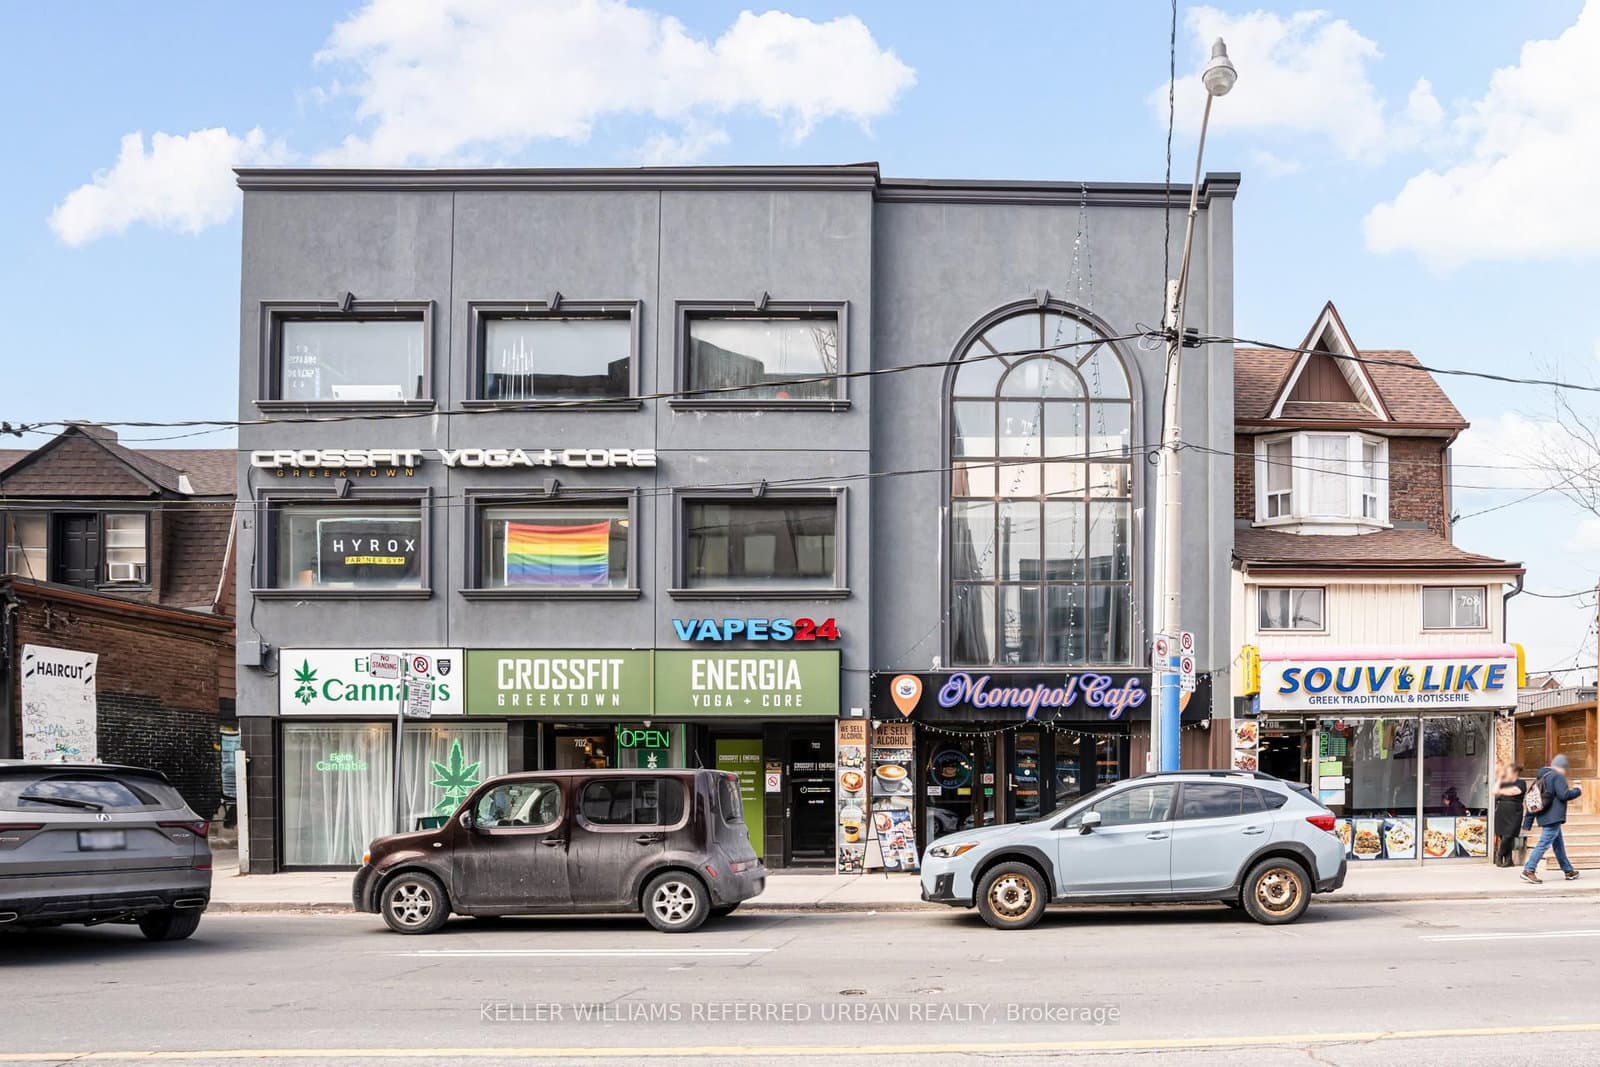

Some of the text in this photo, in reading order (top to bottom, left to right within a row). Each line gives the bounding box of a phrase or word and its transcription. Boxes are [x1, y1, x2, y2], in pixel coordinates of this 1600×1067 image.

[251, 449, 423, 468] CROSSFIT
[437, 449, 534, 468] YOGA
[562, 449, 657, 468] CORE
[276, 469, 415, 478] GREEKTOWN
[333, 539, 415, 553] HYROX
[672, 618, 840, 642] VAPES24
[37, 661, 84, 680] HAIRCUT
[372, 661, 397, 670] STANDING
[497, 658, 624, 690] CROSSFIT
[691, 659, 802, 691] ENERGIA
[497, 693, 620, 706] GREEKTOWN
[693, 695, 733, 707] YOGA
[762, 695, 803, 707] CORE
[938, 672, 1147, 720] Monopol Cafe
[1308, 693, 1470, 705] GREEK TRADITIONAL & ROTISSERIE
[840, 725, 863, 733] WE SELL
[877, 726, 909, 735] WE SELL
[574, 738, 587, 748] 702
[619, 730, 671, 748] OPEN
[876, 735, 909, 746] ALCOHOL
[316, 760, 368, 771] Cannabis
